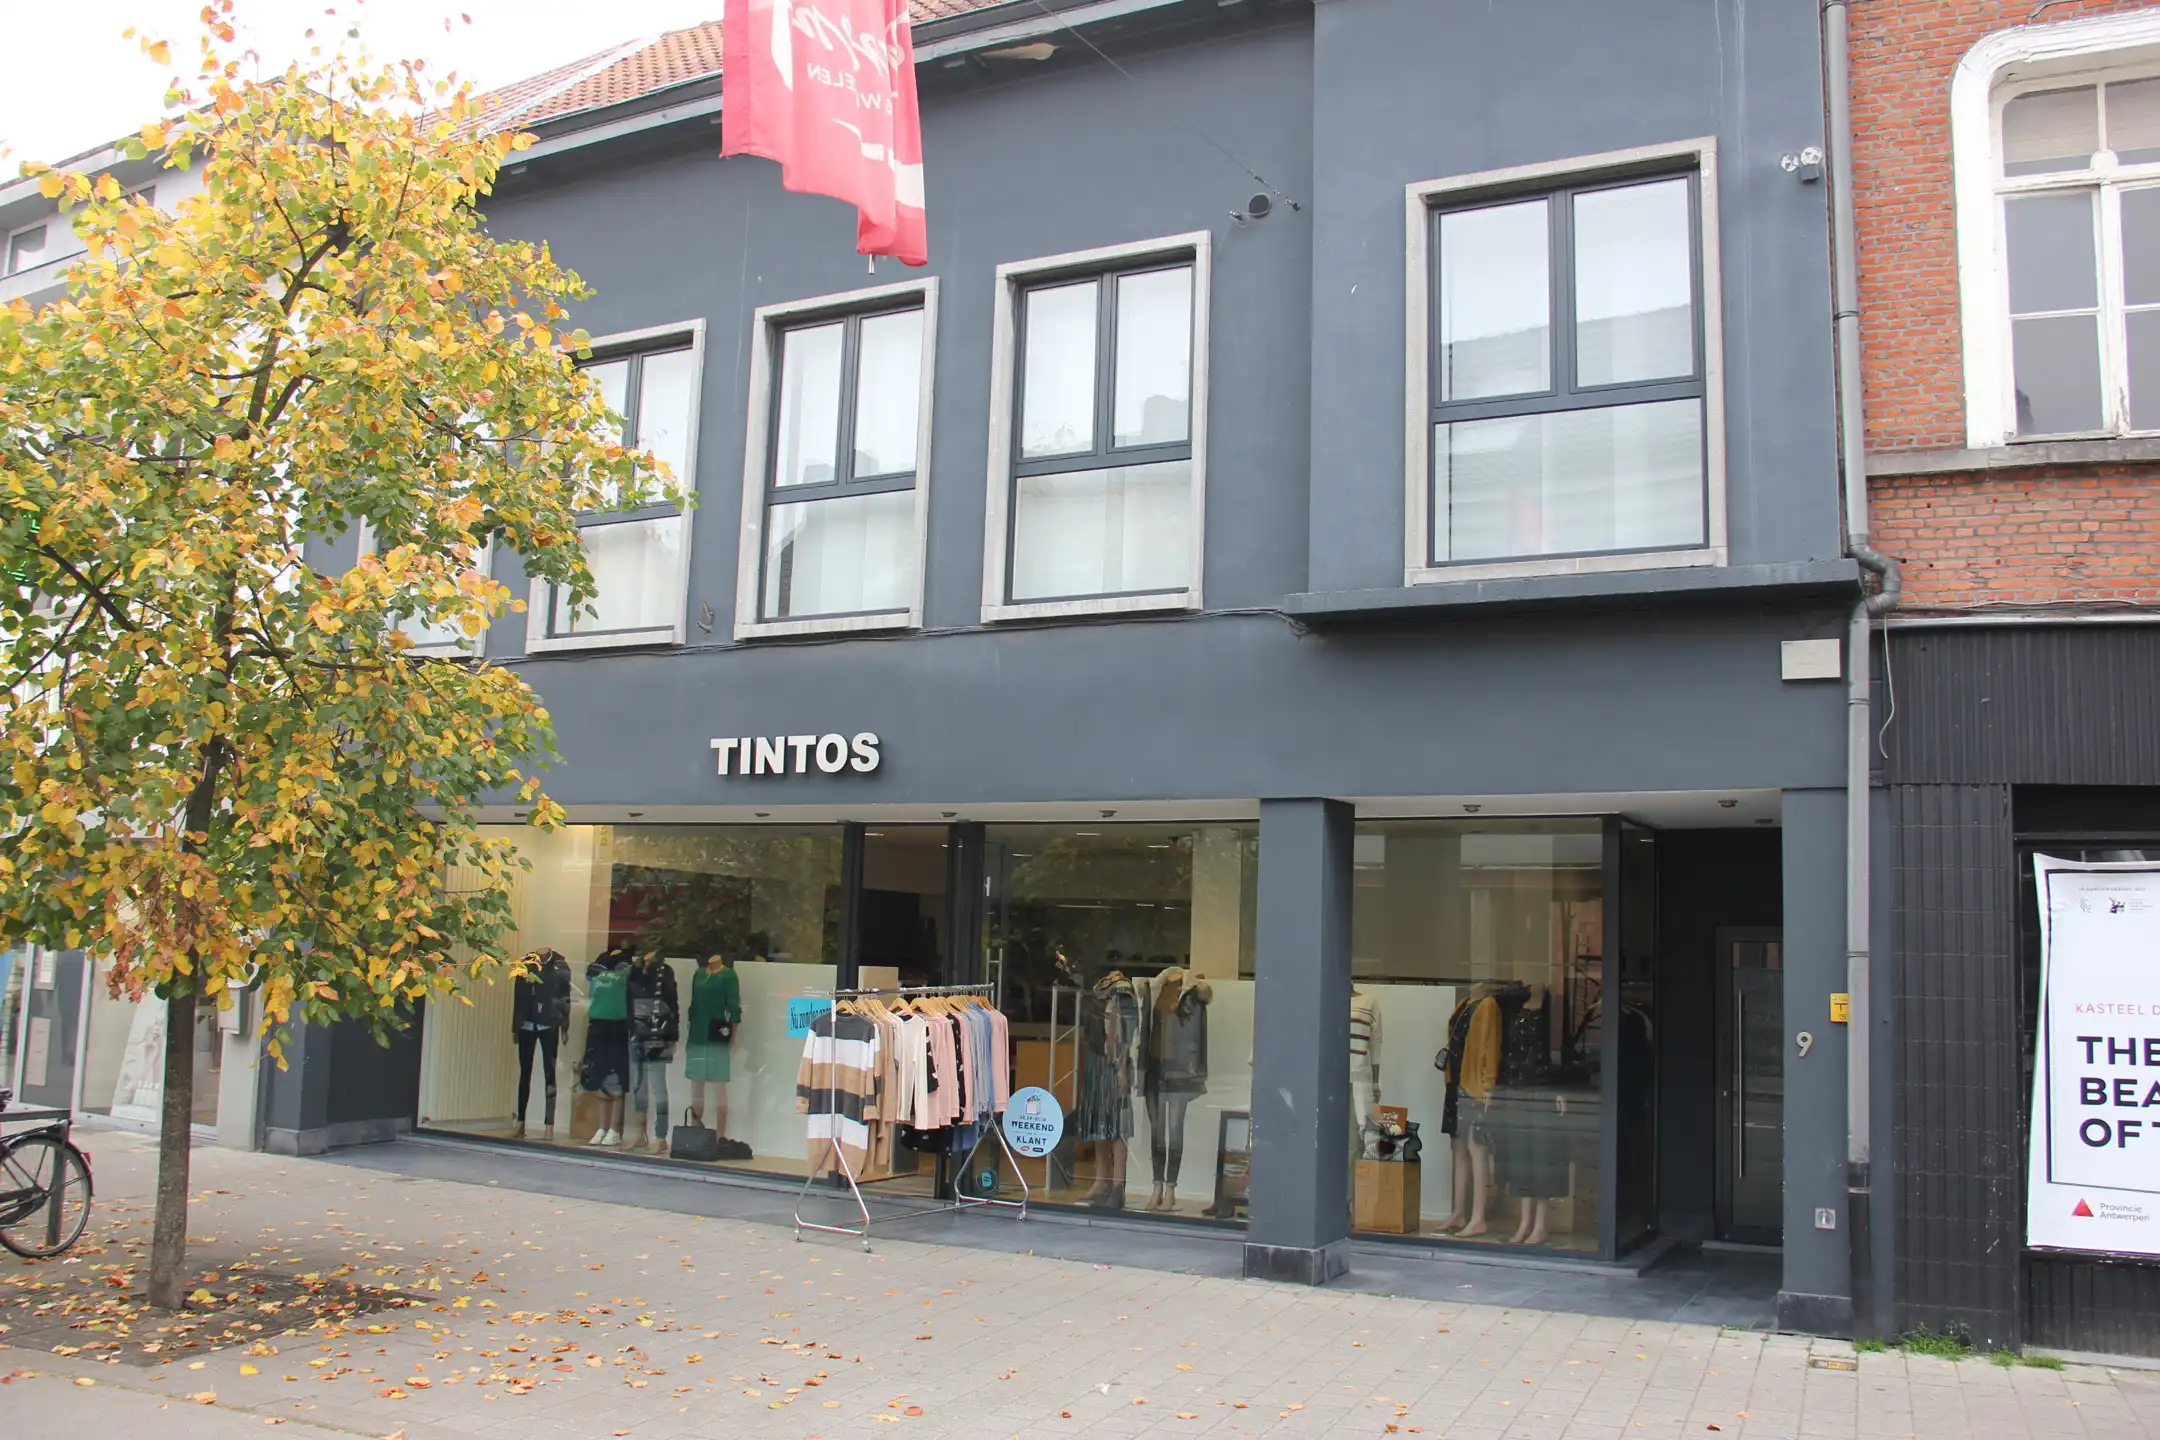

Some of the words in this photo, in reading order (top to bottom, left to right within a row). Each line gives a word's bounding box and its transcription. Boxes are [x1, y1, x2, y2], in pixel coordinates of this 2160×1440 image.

[710, 732, 880, 775] TINTOS
[2075, 1002, 2146, 1016] KASTEEL
[1796, 1031, 1813, 1057] 9
[2076, 1035, 2160, 1067] THE
[1011, 1120, 1055, 1132] WEEKEND
[2079, 1117, 2143, 1149] OF
[1016, 1135, 1048, 1146] KLANT
[2100, 1202, 2143, 1213] Provincie
[2100, 1210, 2151, 1223] Antwerpen
